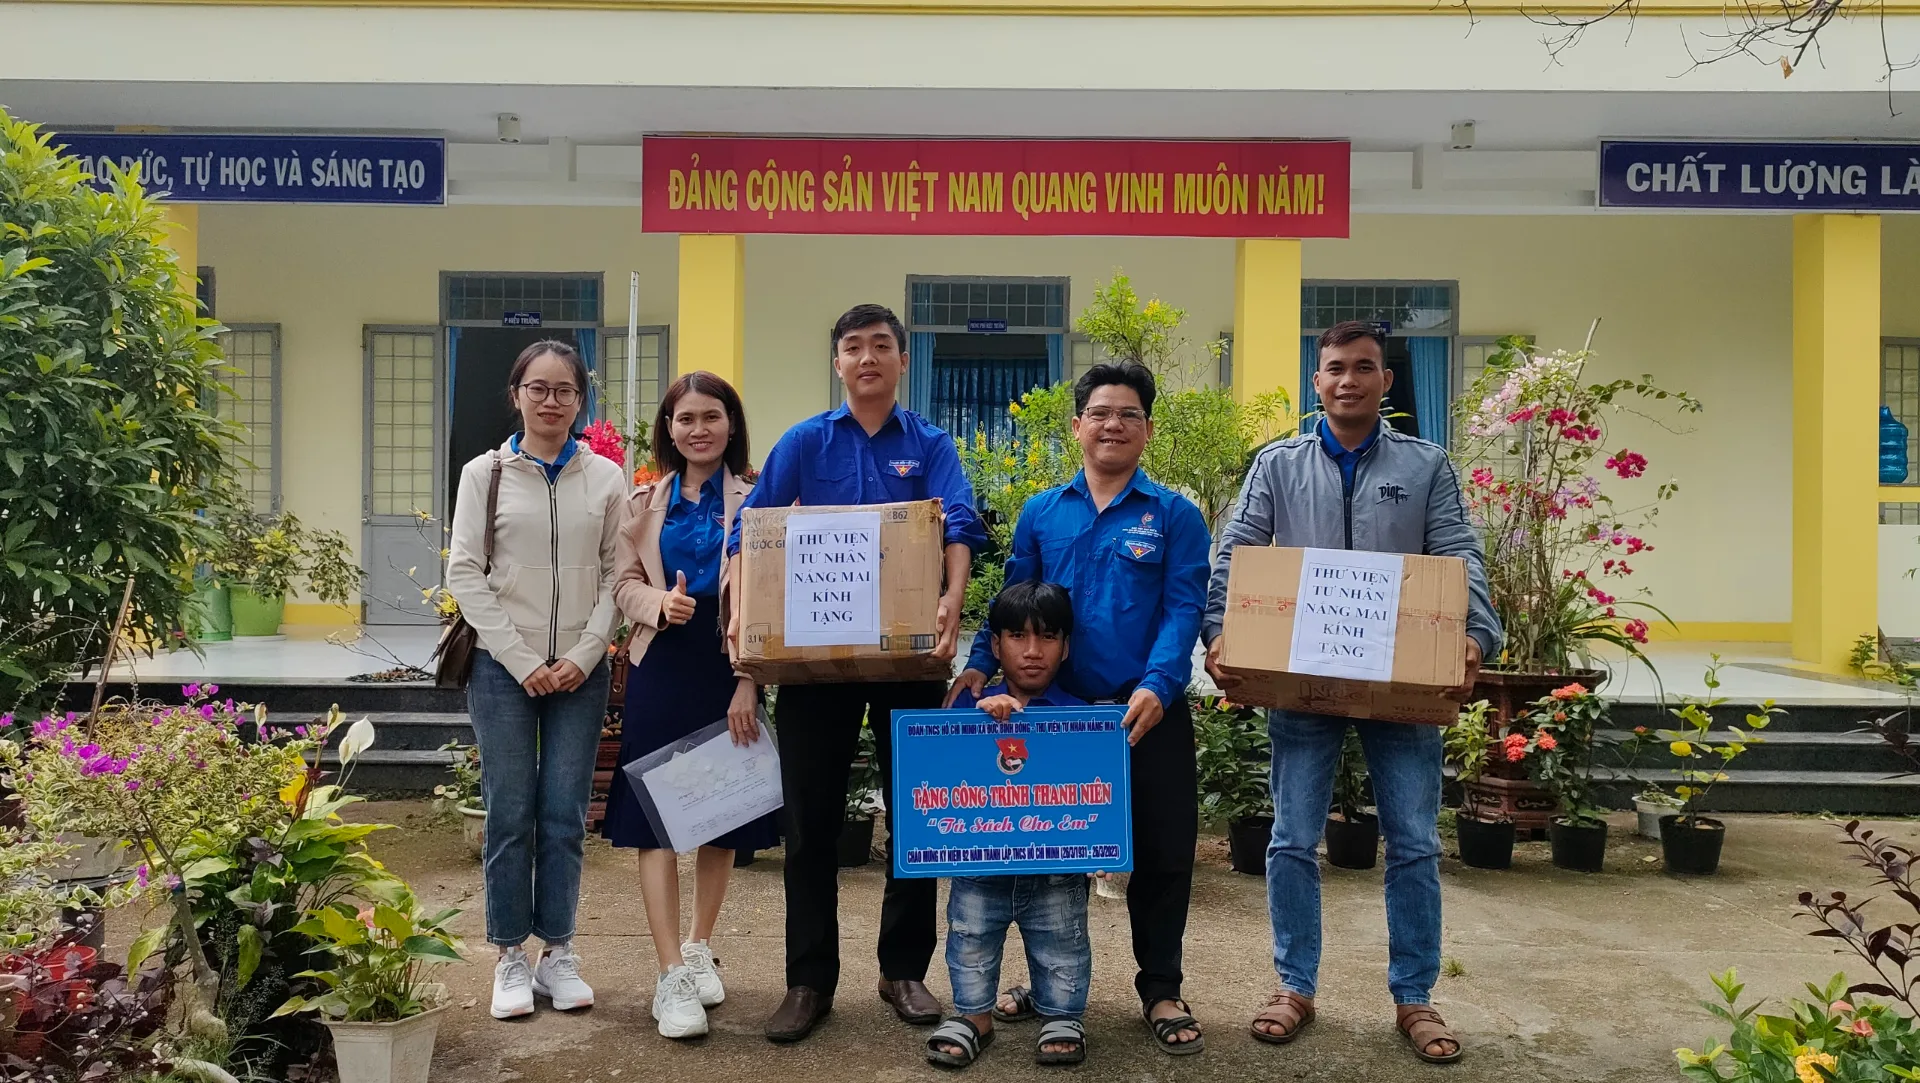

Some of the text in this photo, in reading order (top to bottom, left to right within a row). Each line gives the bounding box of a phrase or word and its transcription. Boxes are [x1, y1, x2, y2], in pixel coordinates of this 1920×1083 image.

[181, 150, 213, 192] TỰ
[220, 155, 267, 192] HỌC
[274, 148, 302, 187] VÀ
[311, 150, 372, 189] SÁNG
[379, 158, 425, 194] TẠO
[1626, 152, 1920, 200] CHẤT LƯỢNG LÀ
[668, 152, 1325, 221] ĐẢNG CỘNG SẢN VIỆT NAM QUANG VINH MUÔN NĂM!
[775, 540, 786, 549] GI
[797, 531, 869, 547] THƯ VIỆN
[799, 548, 867, 565] TƯ NHÂN
[841, 571, 871, 583] MAI
[1312, 567, 1390, 586] THƯ VIỆN
[813, 588, 851, 603] KÍNH
[1313, 584, 1385, 602] TƯ NHÂN
[1355, 608, 1388, 622] MAI
[1323, 621, 1364, 638] KÍNH
[912, 776, 1113, 815] TẶNG CÔNG TRÌNH THANH NIÊN
[969, 815, 1015, 833] Sách
[1018, 814, 1053, 832] Cho
